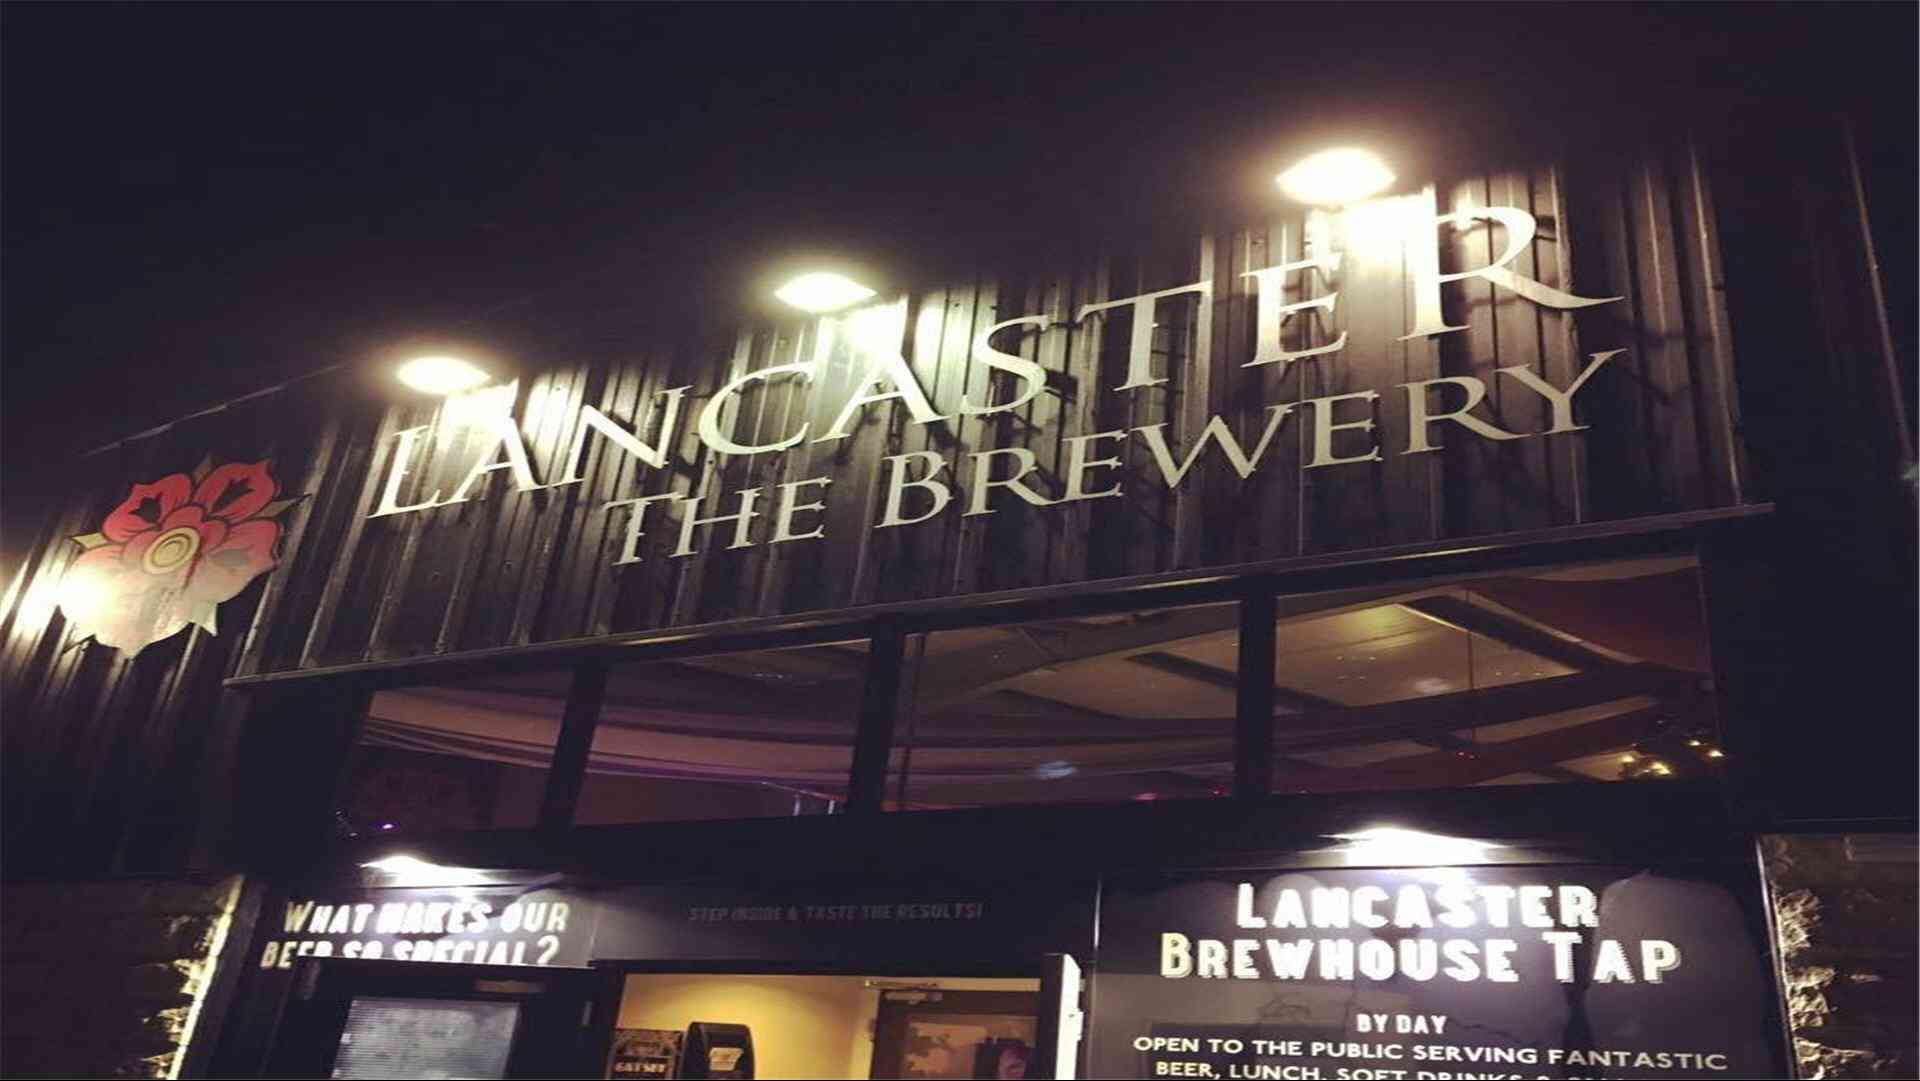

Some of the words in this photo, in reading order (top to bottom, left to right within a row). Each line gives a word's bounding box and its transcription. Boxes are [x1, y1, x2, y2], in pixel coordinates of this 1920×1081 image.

[367, 193, 1625, 519] LANCASTER
[602, 476, 832, 566] THE
[875, 348, 1628, 529] BREWERY
[284, 901, 374, 933] WHAT
[376, 901, 493, 933] MAKES
[499, 902, 571, 933] OUR
[1237, 883, 1600, 929] LANCASTER
[1160, 932, 1520, 982] BREWHOUSE
[1541, 931, 1683, 984] TAP
[1356, 1013, 1389, 1034] BY
[1395, 1014, 1448, 1034] DAY
[1134, 1036, 1199, 1053] OPEN
[1207, 1038, 1244, 1054] TO
[1252, 1039, 1303, 1057] THE
[1311, 1041, 1404, 1060] PUBLIC
[1412, 1045, 1538, 1065] SERVING
[1548, 1049, 1728, 1071] FANTASTIC
[1155, 1061, 1221, 1080] BEER,
[1336, 1067, 1408, 1080] SOFT
